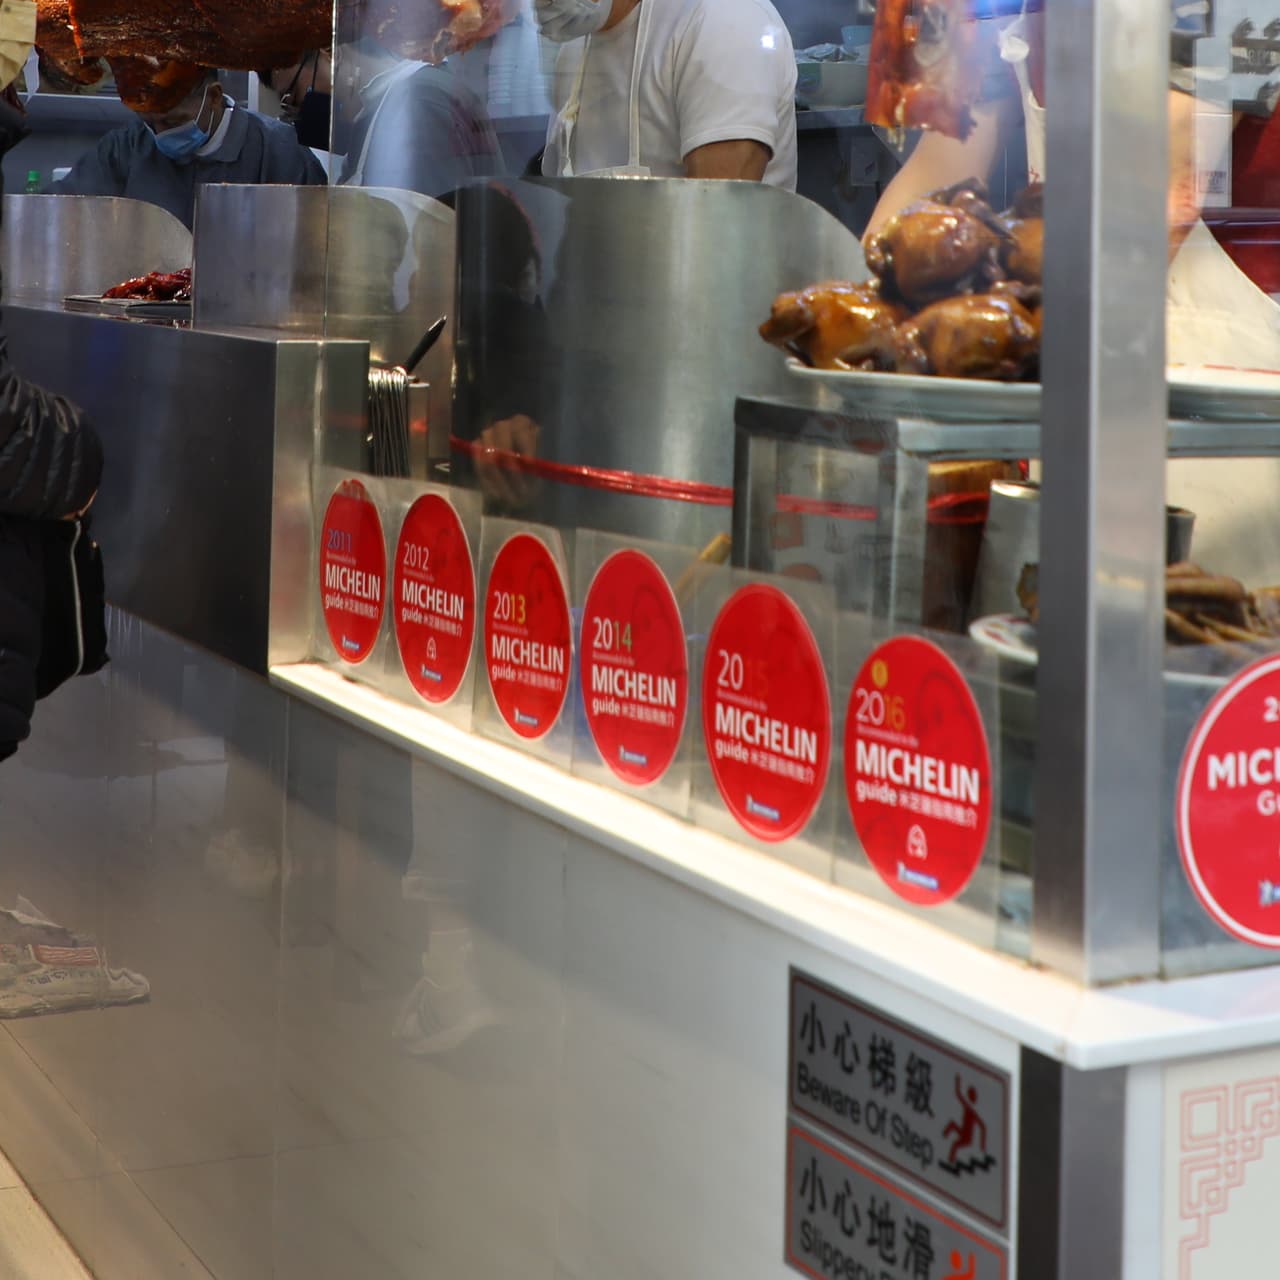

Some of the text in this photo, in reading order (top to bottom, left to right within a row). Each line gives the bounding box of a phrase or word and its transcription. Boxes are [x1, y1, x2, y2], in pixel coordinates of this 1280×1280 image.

[327, 529, 352, 553] 2011
[404, 542, 430, 570] 2012
[325, 562, 381, 601] MICHELIN
[402, 579, 464, 620] MICHELIN
[325, 593, 344, 610] guide
[402, 606, 423, 623] guide
[493, 591, 526, 624] 2013
[593, 616, 633, 653] 2014
[492, 634, 564, 675] MICHELIN
[492, 664, 515, 682] guide
[592, 663, 676, 708] MICHELIN
[592, 696, 620, 716] guide
[855, 687, 905, 732] 2016
[715, 701, 817, 764] MICHELIN
[715, 738, 749, 764] guide
[855, 738, 980, 806] MICHELIN
[856, 779, 898, 807] guide
[800, 1001, 935, 1119] 小心梯級
[796, 1062, 934, 1168] Beware Of Step
